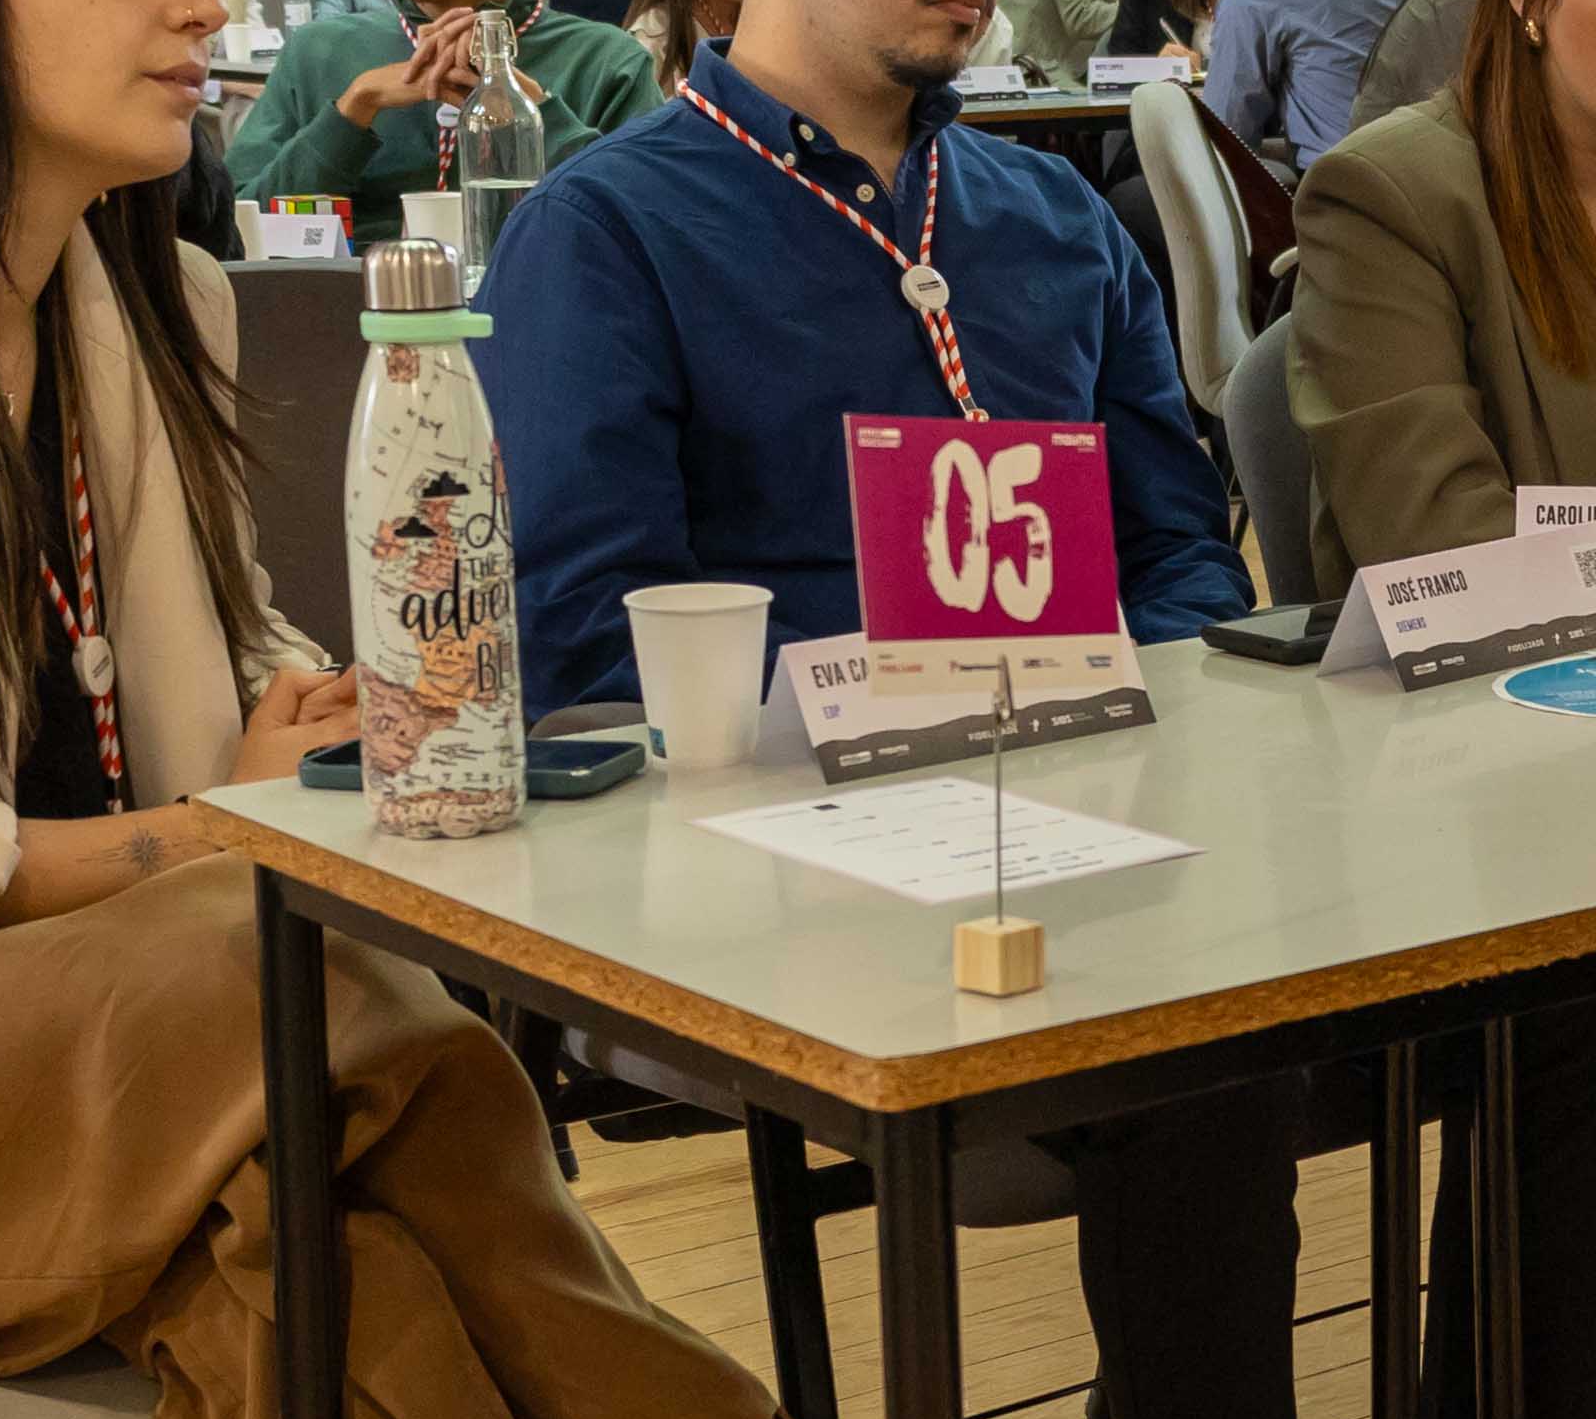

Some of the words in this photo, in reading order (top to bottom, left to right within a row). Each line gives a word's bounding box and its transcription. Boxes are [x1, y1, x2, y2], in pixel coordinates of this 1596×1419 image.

[923, 438, 1053, 622] 05
[1386, 572, 1418, 606] JOSÉ
[1420, 569, 1468, 600] FRANCO
[1396, 617, 1427, 632] SIEMENS
[812, 661, 845, 688] EVA
[823, 703, 841, 720] EDP
